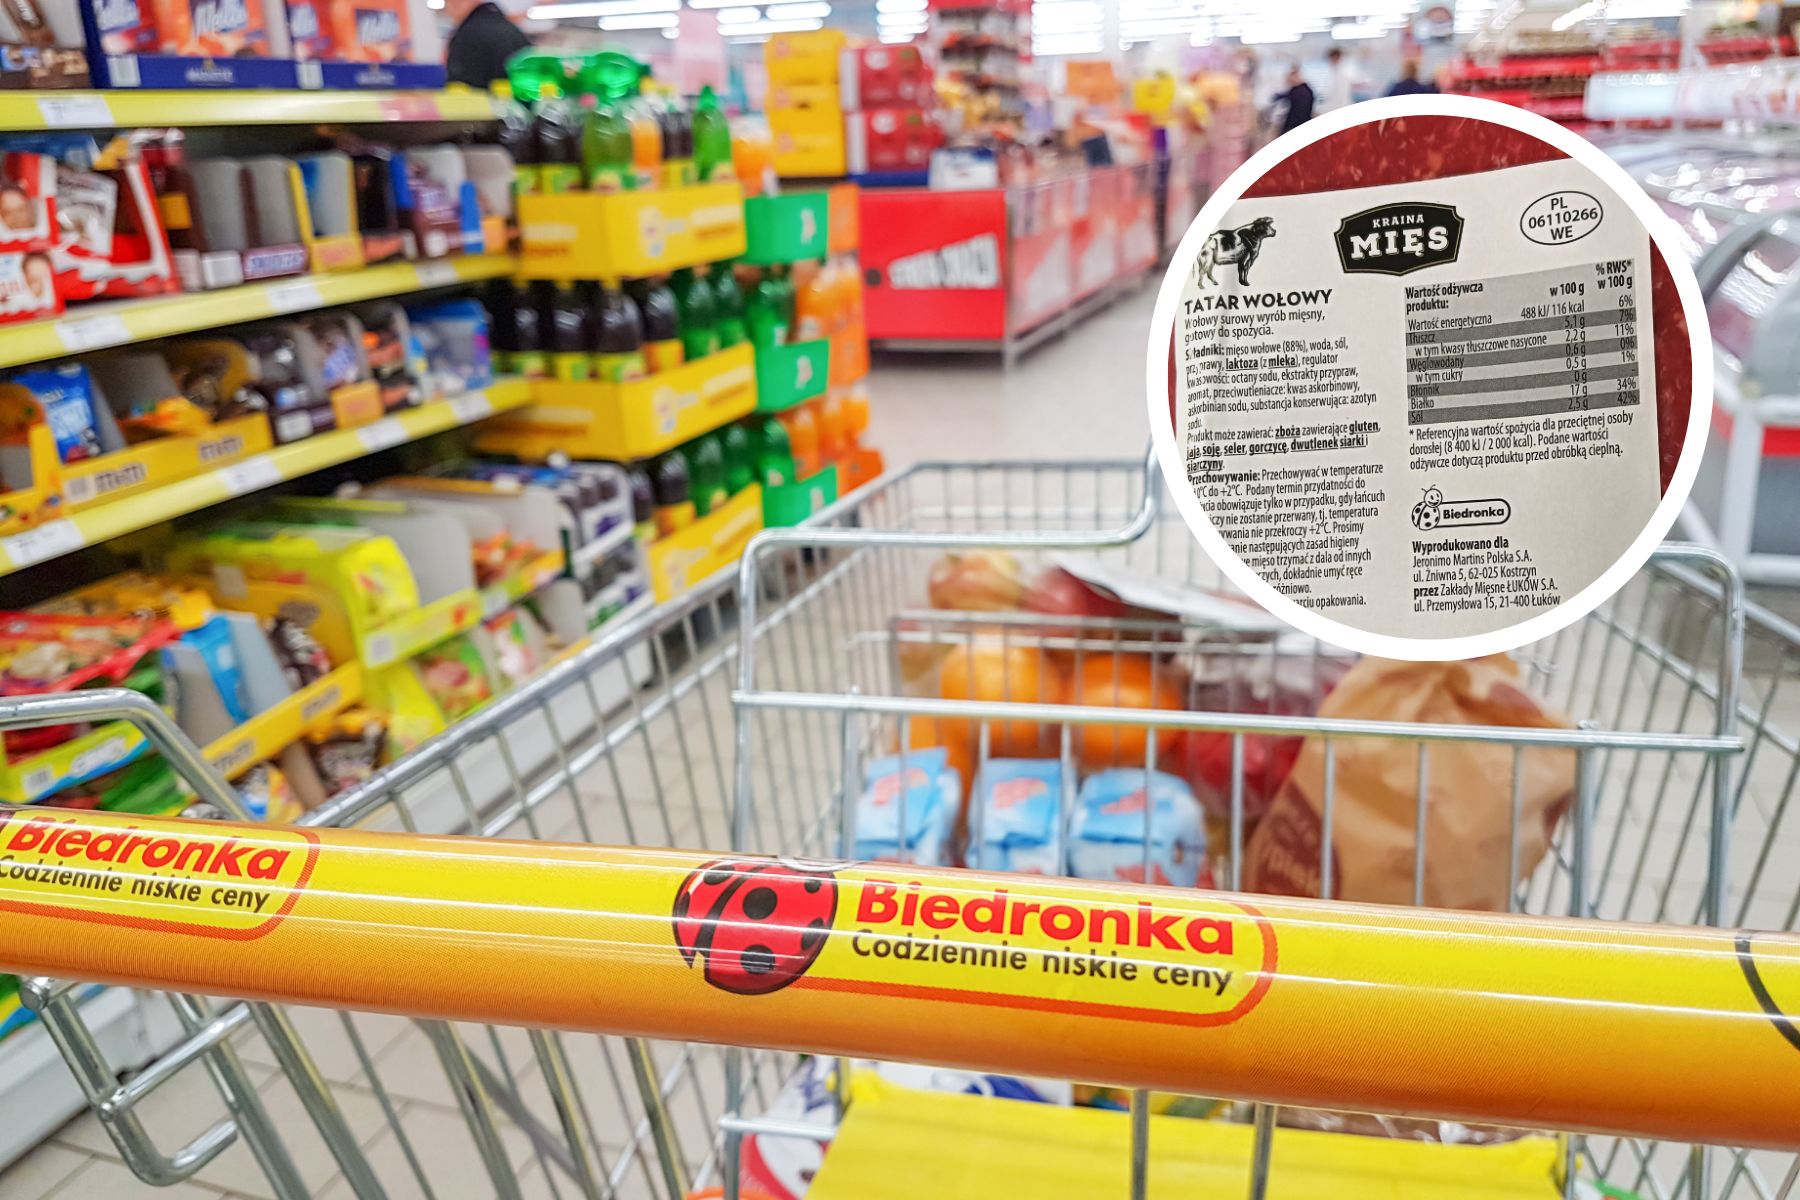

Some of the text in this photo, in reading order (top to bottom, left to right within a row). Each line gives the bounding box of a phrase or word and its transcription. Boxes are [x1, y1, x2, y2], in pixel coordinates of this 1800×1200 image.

[1551, 197, 1568, 210] PL
[1372, 214, 1424, 229] KRAINA
[1528, 207, 1598, 229] 06110266
[1350, 225, 1449, 260] MIĘS
[1551, 225, 1573, 241] WE
[1405, 282, 1483, 299] Wartość odżywcza
[1560, 283, 1576, 295] 100
[1608, 276, 1624, 288] 100
[1184, 289, 1333, 315] TATAR WOŁOWY
[1406, 299, 1449, 315] produktu:
[1220, 308, 1326, 327] surowy wyrób mięsny,
[1408, 295, 1634, 331] Wartość energetyczna 488 116 kcal 6%
[1564, 316, 1577, 329] 5,1
[1619, 308, 1634, 321] 7%
[1218, 325, 1230, 338] do
[1424, 323, 1634, 357] tym kwasy tłuszczowe nasycone 2,2 11%
[1225, 344, 1249, 359] mięso
[1250, 341, 1281, 355] wołowe
[1309, 339, 1333, 352] woda,
[1334, 337, 1348, 350] sól,
[1409, 337, 1635, 372] Węglowodany 0,6 0%
[1225, 353, 1338, 370] laktoza mleka), regulator
[1425, 350, 1635, 383] tym cukry 0,5 1%
[1231, 368, 1359, 386] octany sodu, ekstrakty przypraw,
[1213, 380, 1360, 402] przeciwutleniacze: kwas askorbinowy,
[1410, 377, 1636, 409] Białko 17 34%
[1228, 400, 1249, 414] sodu,
[1250, 397, 1292, 412] substancja
[1293, 395, 1349, 410] konserwująca:
[1350, 393, 1377, 405] azotyn
[1411, 391, 1637, 424] Sól 2,5 42%
[1214, 421, 1381, 440] może zawierać: zboża zawierające gluten,
[1416, 411, 1633, 441] Referencyjna wartość spożycia dla przeciętnej osoby
[1223, 435, 1364, 456] seler, gorczycę, dwutlenek siarki
[1409, 428, 1609, 457] dorosłej 400 000 kcal). Podane wartości
[1410, 443, 1624, 472] odżywcze dotyczą produktu przed obróbką cieplną.
[1261, 463, 1383, 482] Przechowywać temperaturze
[1208, 479, 1353, 499] do Podany termin przydatności
[1216, 490, 1385, 513] obowiązuje tylko przypadku, gdy łańcuch
[1226, 513, 1239, 525] nie
[1239, 512, 1272, 524] zostanie
[1274, 511, 1318, 526] przerwany,
[1329, 507, 1379, 522] temperatura
[1443, 506, 1504, 520] Biedronka
[1251, 521, 1364, 540] nie przekroczy Prosimy
[1248, 535, 1359, 555] następujących zasad higieny
[1412, 536, 1509, 555] Wyprodukowano dla
[1251, 549, 1372, 570] mięso trzymać dala innych
[1412, 550, 1532, 568] Jeronimo Martins Polska S.A.
[1283, 565, 1363, 580] dokładnie umyć ręce
[1426, 565, 1537, 582] Żniwna 62-025 Kostrzyn
[1413, 578, 1558, 599] przez Zakłady Mięsne ŁUKÓW S.A.
[1316, 595, 1367, 609] opakowania.
[1426, 592, 1561, 613] Przemysłowa 15, 21-400 Łuków
[6, 816, 291, 880] Biedronka
[0, 855, 270, 913] Codziennie niskie ceny
[856, 879, 1234, 955] Biedronka
[851, 929, 1234, 996] Codziennie niskie ceny
